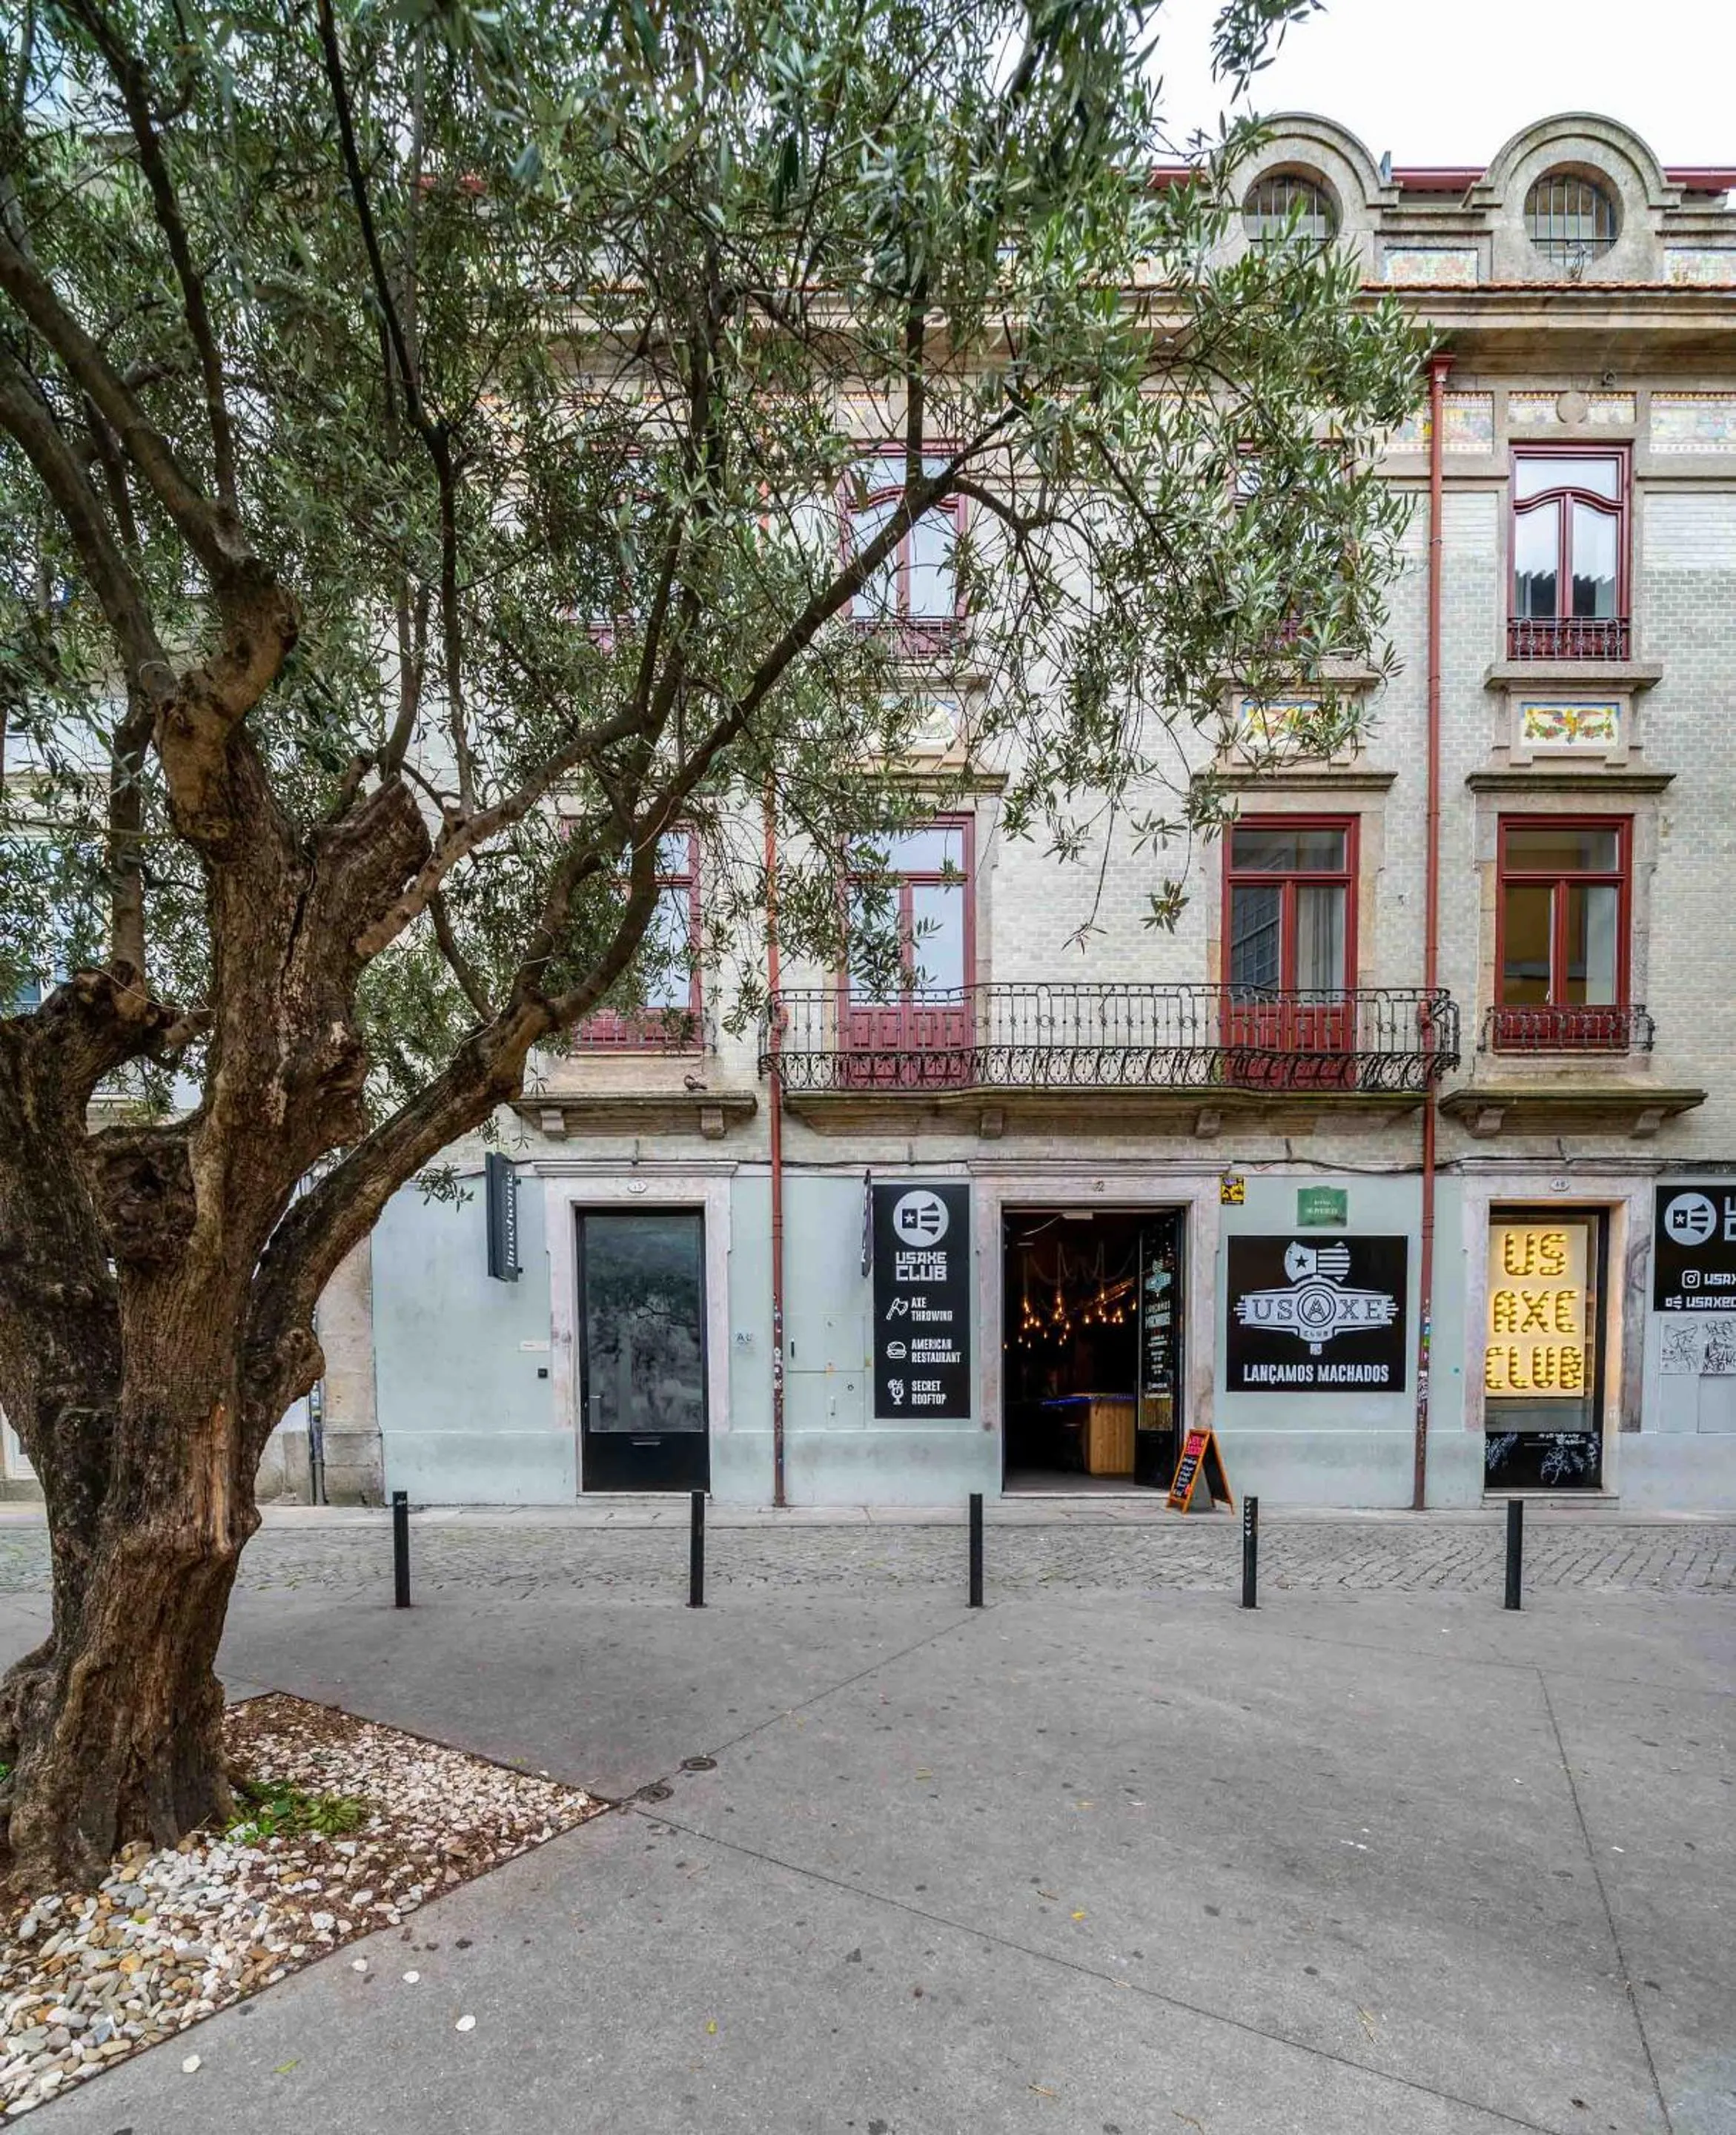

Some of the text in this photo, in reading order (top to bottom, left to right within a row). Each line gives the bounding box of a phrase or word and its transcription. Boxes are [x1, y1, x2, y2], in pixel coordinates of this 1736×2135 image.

[1504, 1233, 1566, 1276] US
[895, 1265, 947, 1281] CLUB
[911, 1297, 927, 1308] AXE
[911, 1310, 953, 1322] THROWING
[1493, 1290, 1577, 1333] AXE
[911, 1339, 952, 1350] AMERICAN
[911, 1351, 961, 1363] RESTAURANT
[1485, 1345, 1582, 1390] CLUB
[1243, 1364, 1389, 1384] LANÇAMOS MACHADOS
[911, 1380, 941, 1391] SECRET
[911, 1394, 947, 1405] ROOFTOP
